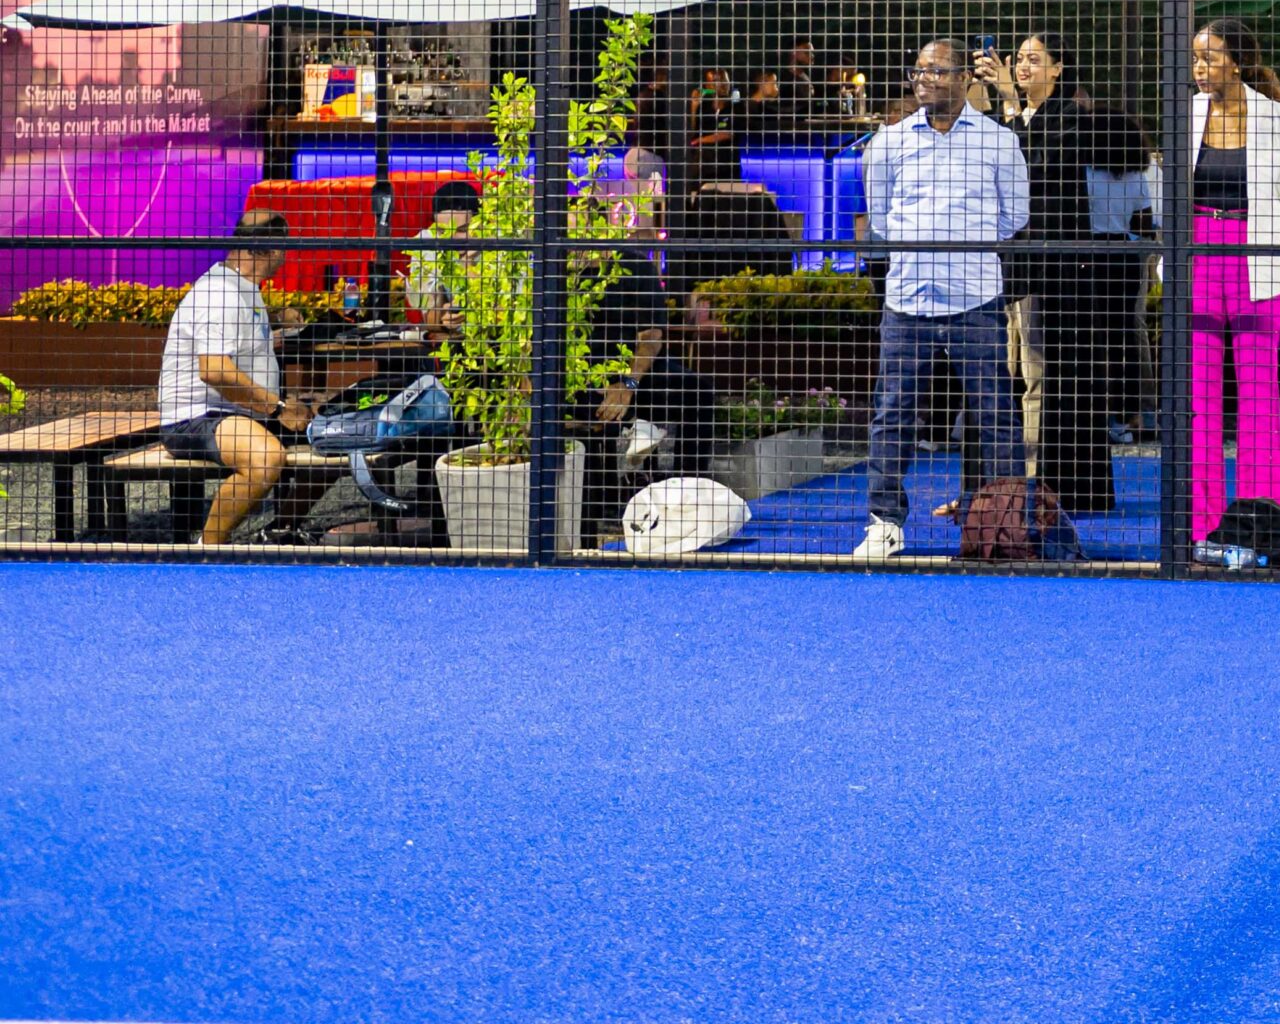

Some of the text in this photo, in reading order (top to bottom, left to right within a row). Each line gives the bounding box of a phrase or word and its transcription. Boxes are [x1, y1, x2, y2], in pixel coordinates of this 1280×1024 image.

[25, 84, 77, 112] Staying
[80, 84, 122, 105] Ahead
[125, 83, 139, 105] of
[142, 84, 163, 105] the
[15, 117, 34, 139] On
[37, 117, 60, 138] the
[64, 117, 100, 137] court
[102, 115, 127, 136] and
[145, 114, 166, 133] the
[169, 113, 211, 133] Market
